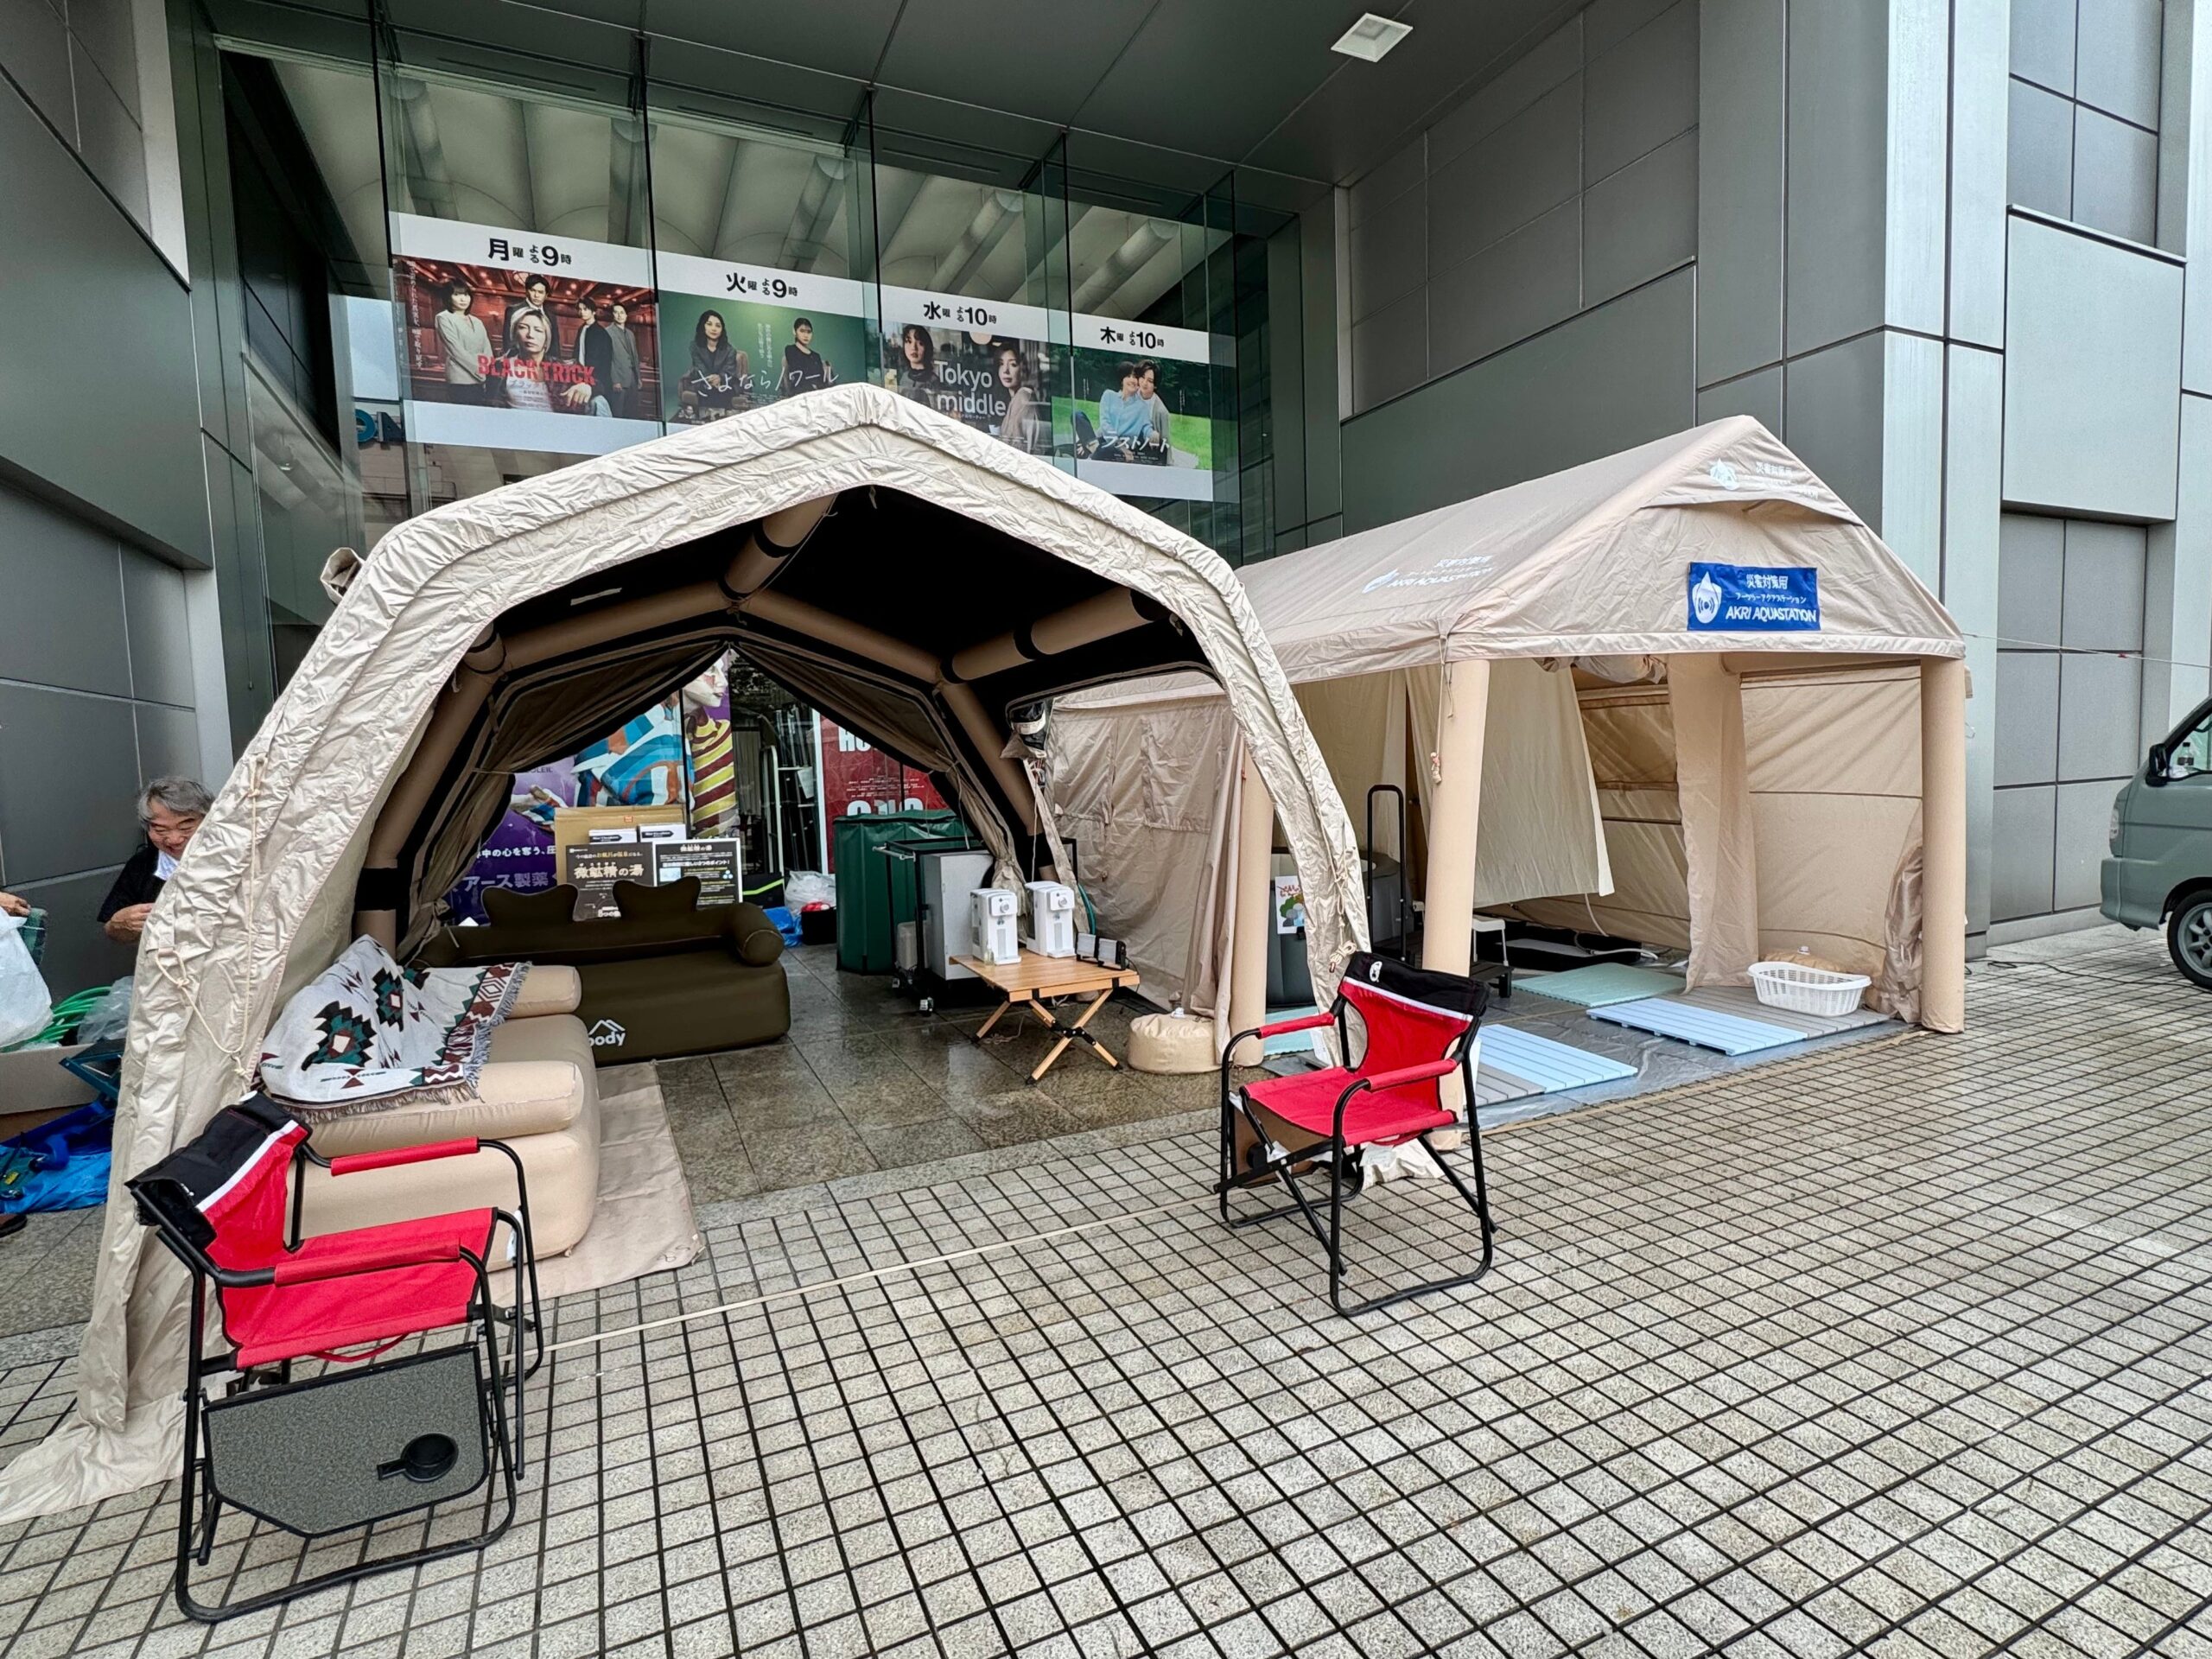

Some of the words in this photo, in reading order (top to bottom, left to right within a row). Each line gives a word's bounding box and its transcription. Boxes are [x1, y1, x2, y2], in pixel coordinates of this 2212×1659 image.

[477, 354, 539, 380] BLACK
[541, 361, 596, 386] TRICK
[691, 366, 840, 397] さよならノワール
[933, 359, 993, 392] Tokyo
[937, 391, 1007, 416] middle
[1726, 606, 1751, 620] AKRI
[1752, 606, 1816, 622] AQUASTATION
[462, 872, 549, 892] アース製薬
